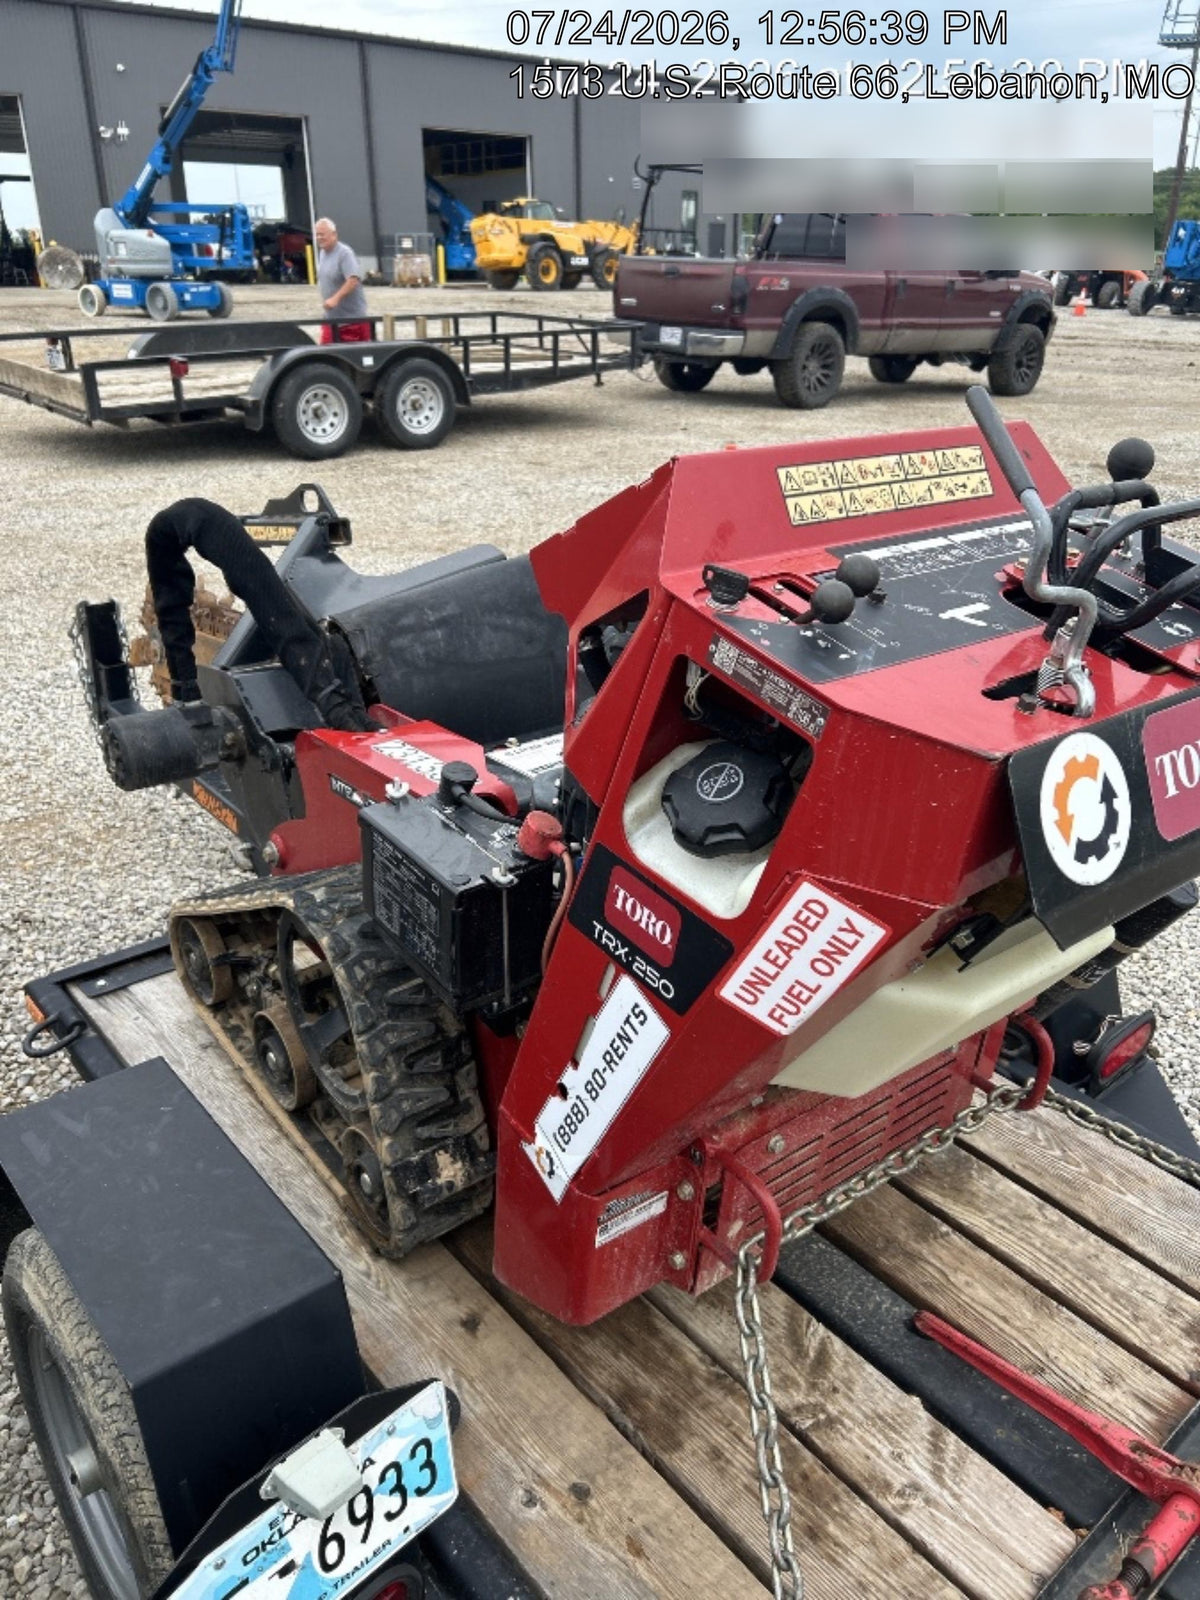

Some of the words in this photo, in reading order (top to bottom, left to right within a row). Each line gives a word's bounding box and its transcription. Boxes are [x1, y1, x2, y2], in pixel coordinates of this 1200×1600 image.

[1155, 740, 1200, 799] TO
[614, 884, 673, 946] TORO
[734, 898, 829, 1006] UNLEADED
[768, 979, 822, 1028] FUEL
[810, 916, 865, 979] ONLY
[552, 1095, 591, 1153] (888)
[583, 1001, 649, 1103] 80-RENTS
[318, 1438, 438, 1573] 6933
[333, 1538, 393, 1591] TRAILER
